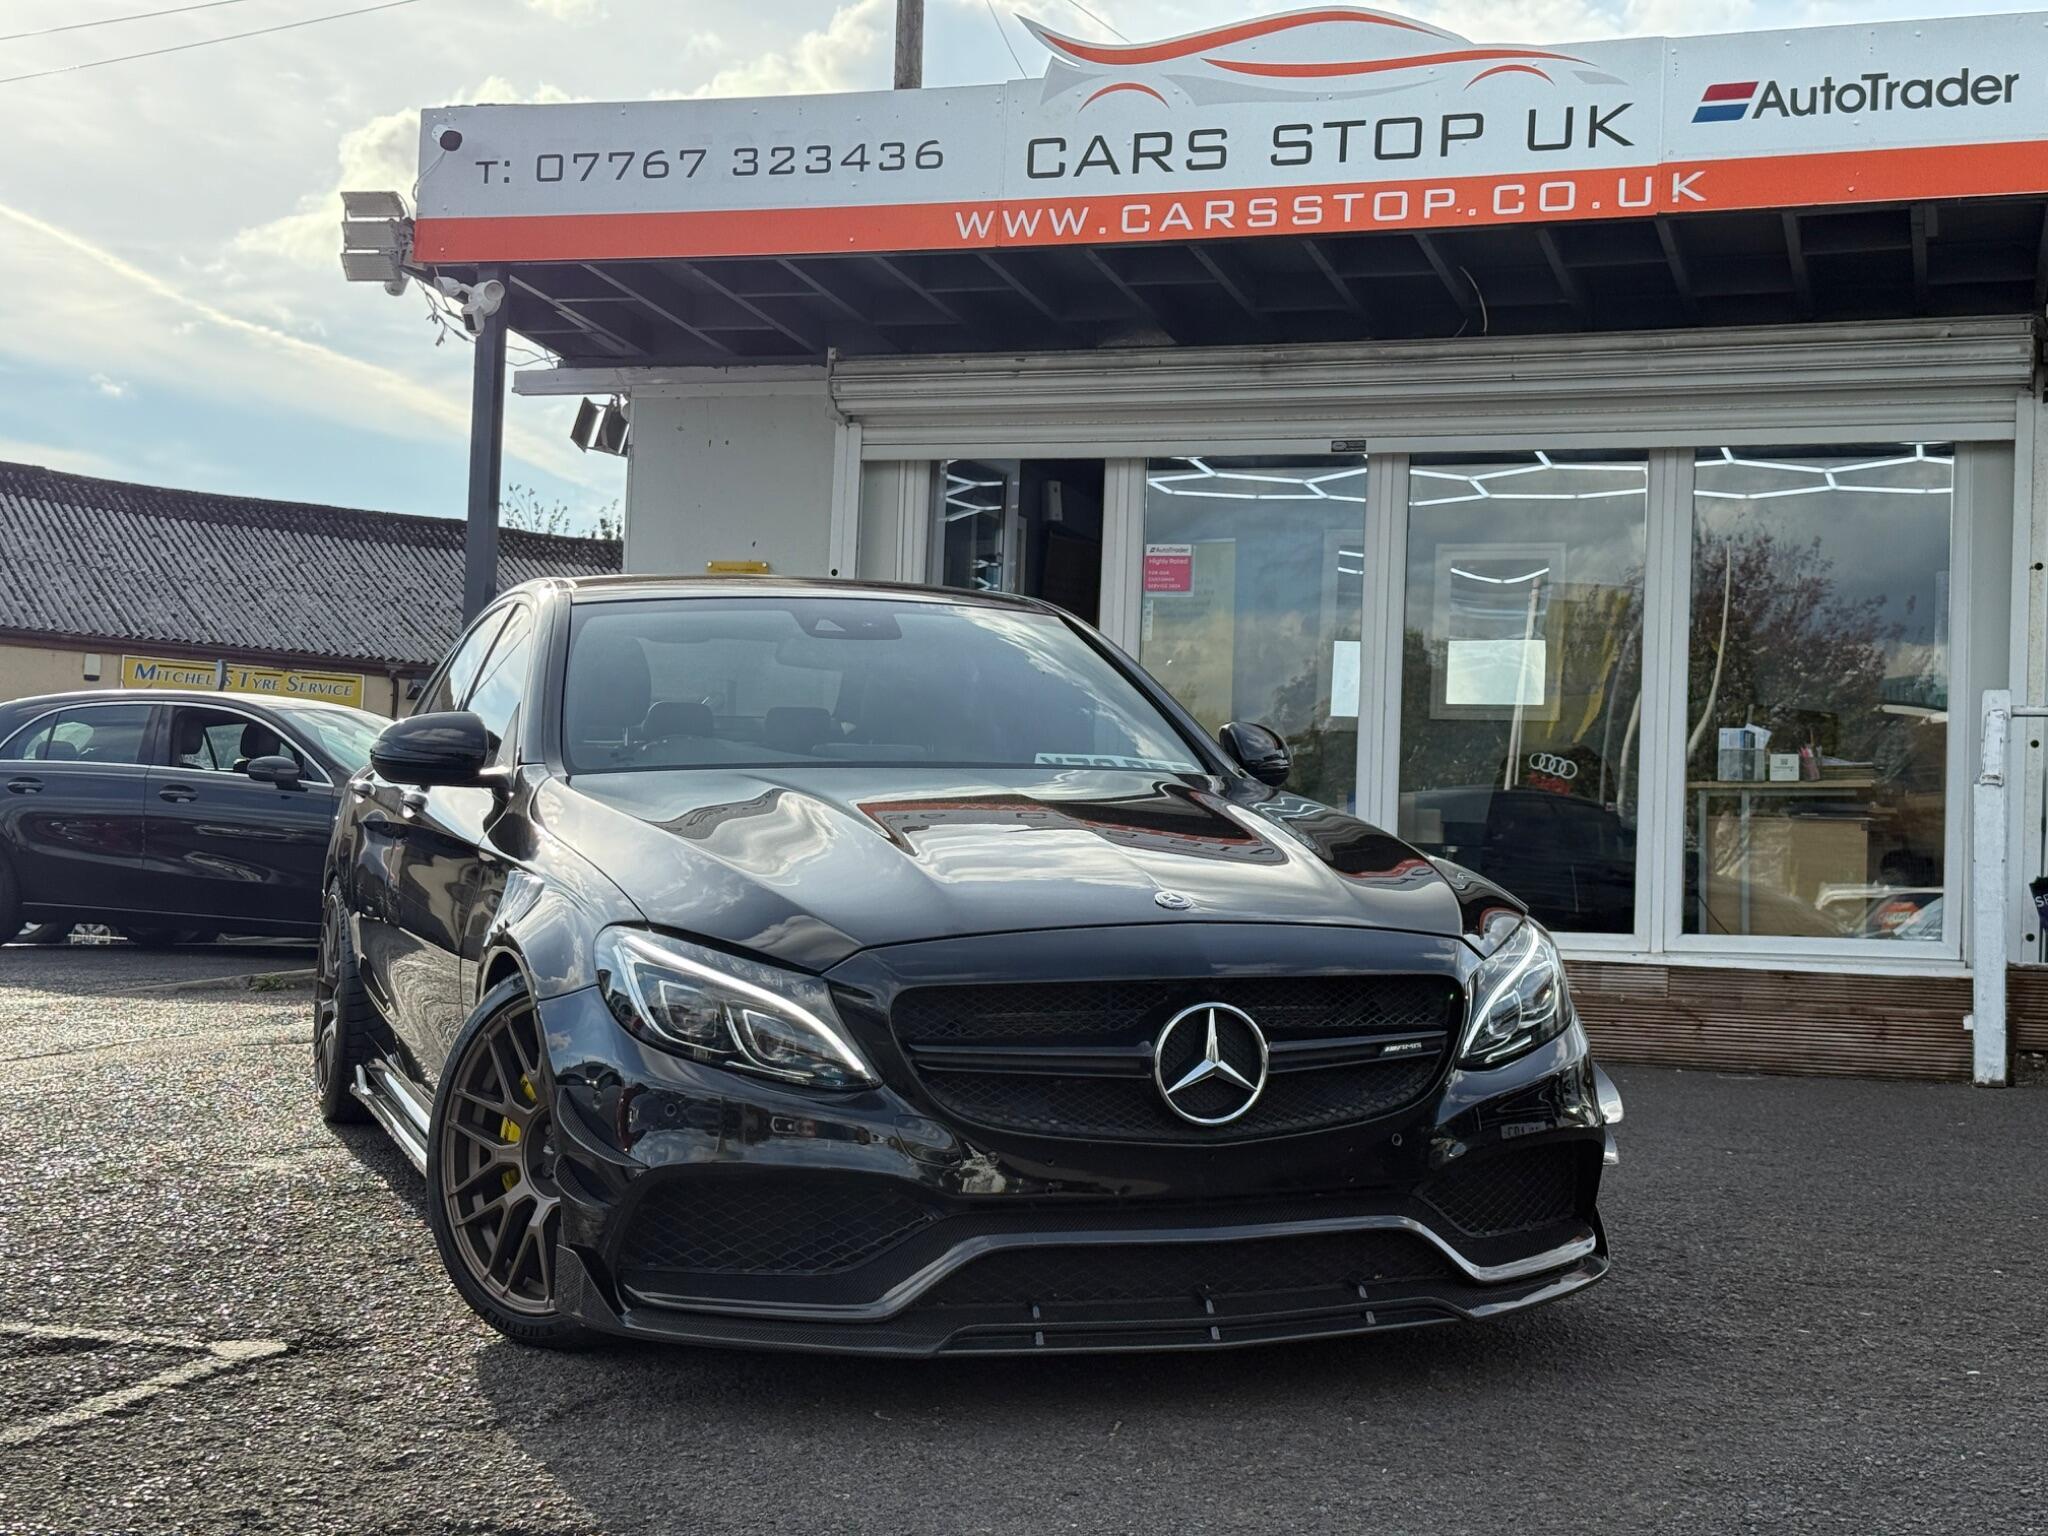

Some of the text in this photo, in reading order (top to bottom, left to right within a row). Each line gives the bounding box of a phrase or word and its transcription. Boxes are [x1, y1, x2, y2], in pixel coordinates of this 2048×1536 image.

[1751, 67, 2020, 119] AutoTrader
[474, 139, 944, 185] T: 07767 323436
[1026, 103, 1634, 179] CARS STOP UK
[955, 171, 1706, 240] WWW.CARSSTOP.CO.UK
[238, 670, 280, 691] TYRE
[286, 676, 353, 697] SERVICE
